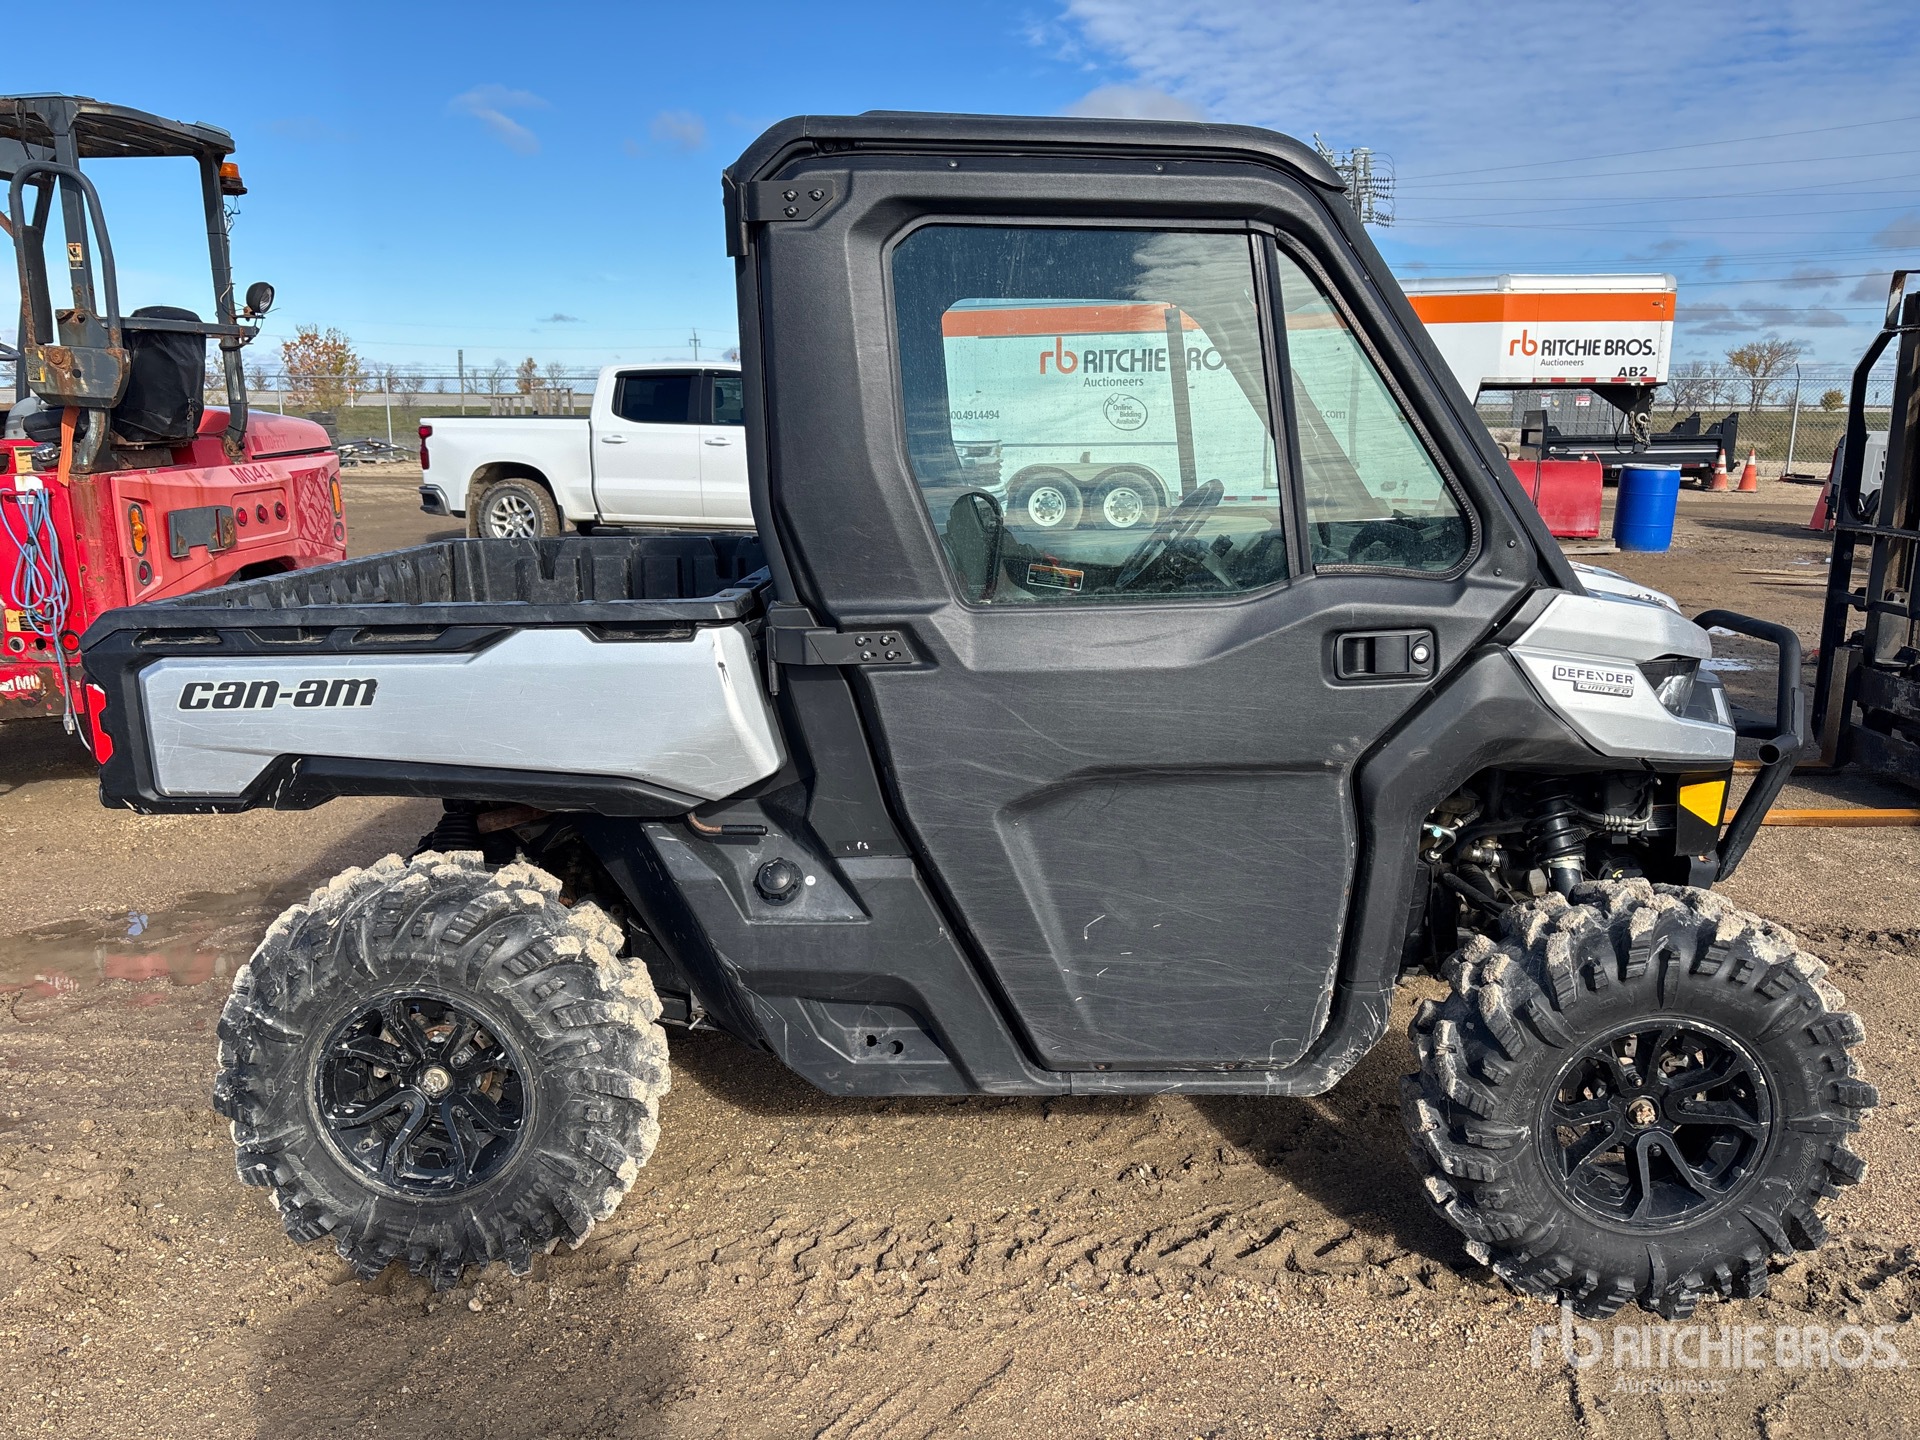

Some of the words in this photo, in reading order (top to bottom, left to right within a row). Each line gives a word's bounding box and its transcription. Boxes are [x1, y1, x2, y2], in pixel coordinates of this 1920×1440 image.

[1540, 339, 1602, 356] RITCHIE
[1604, 338, 1656, 356] BROS.
[1083, 348, 1167, 373] RITCHIE
[1540, 358, 1585, 367] Auctioneers
[1617, 366, 1648, 377] AB2
[1083, 376, 1144, 388] Auctioneers
[950, 410, 1000, 420] 00.491.4494
[1120, 411, 1142, 419] Bidding
[1557, 667, 1634, 685] DEFENDER
[178, 678, 378, 710] can-am
[1580, 684, 1631, 695] LIMITED
